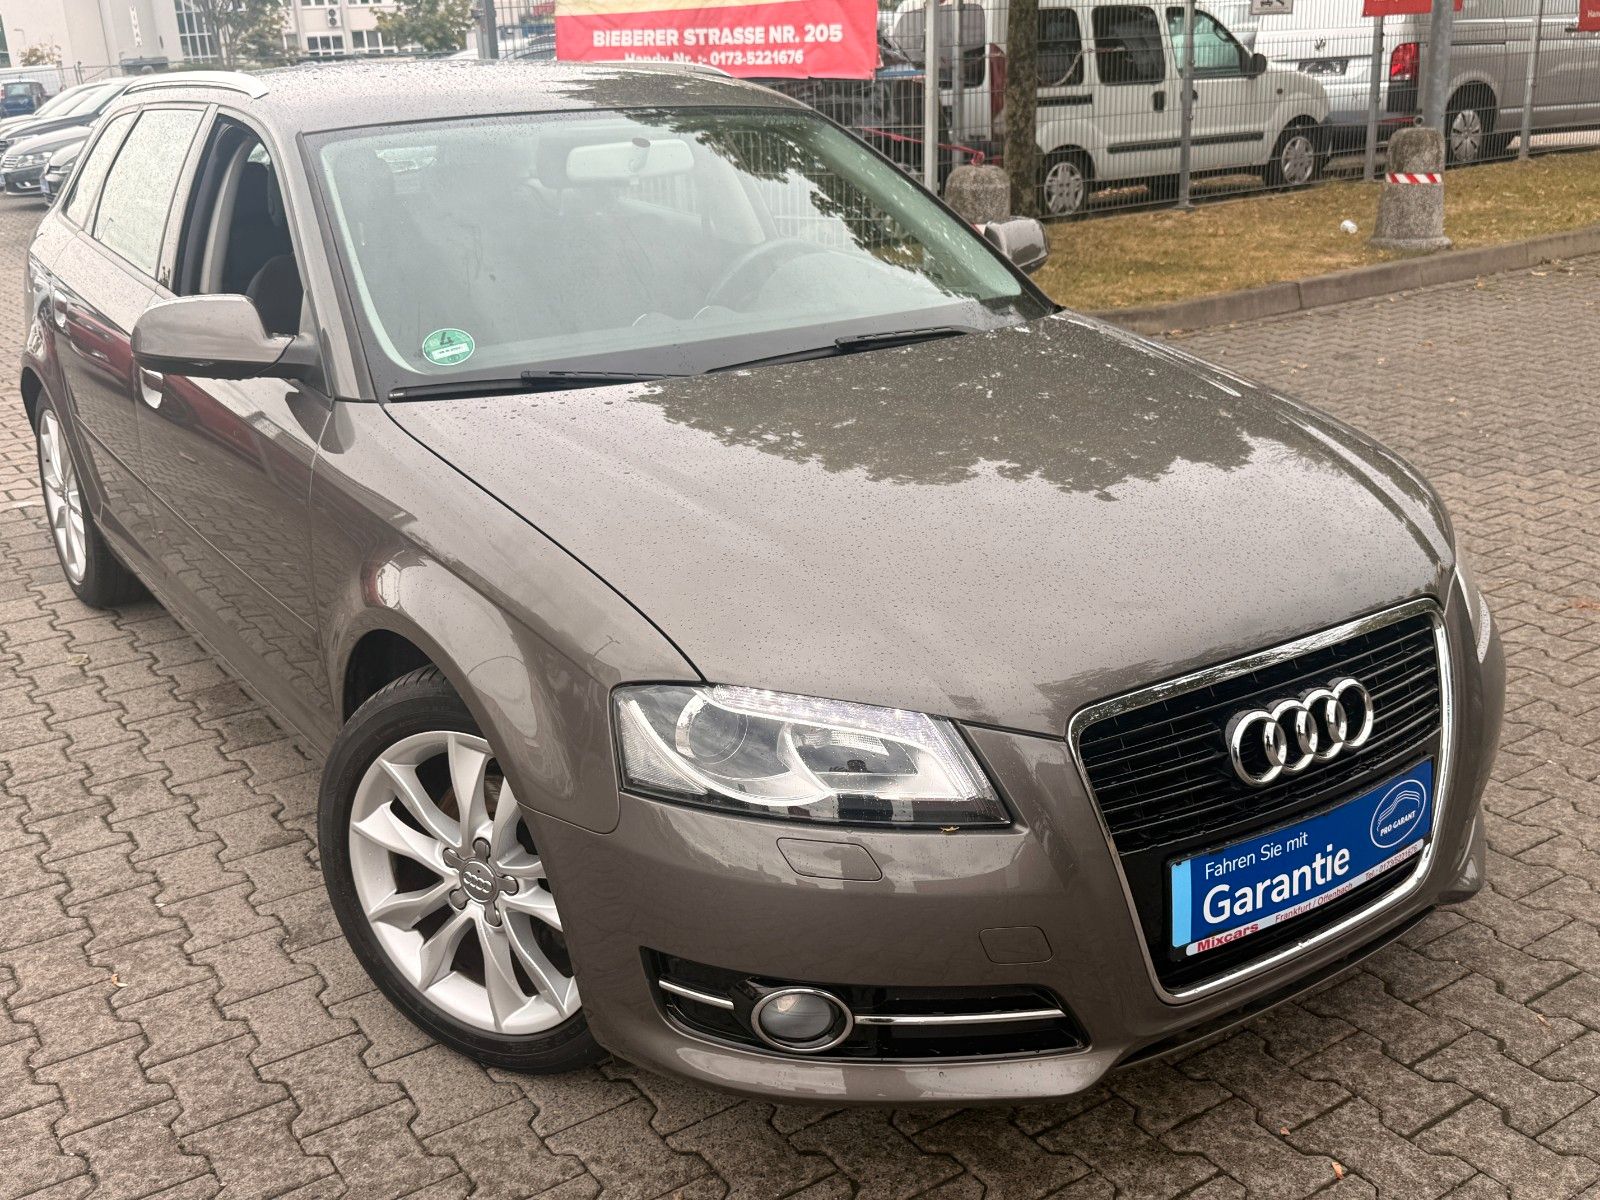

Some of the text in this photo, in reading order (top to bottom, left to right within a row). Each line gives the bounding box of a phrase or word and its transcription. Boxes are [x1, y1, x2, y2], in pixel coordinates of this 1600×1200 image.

[592, 24, 843, 47] BIEBERER STRASSE NR. 205
[709, 50, 804, 66] 0173-5221676
[1380, 810, 1416, 837] PRO GARANT
[1205, 832, 1308, 880] Fahren Sie mit
[1203, 843, 1350, 924] Garantie
[1197, 922, 1259, 952] Mixcars
[1275, 902, 1311, 923] Frankfurt
[1317, 883, 1353, 905] Offenbach
